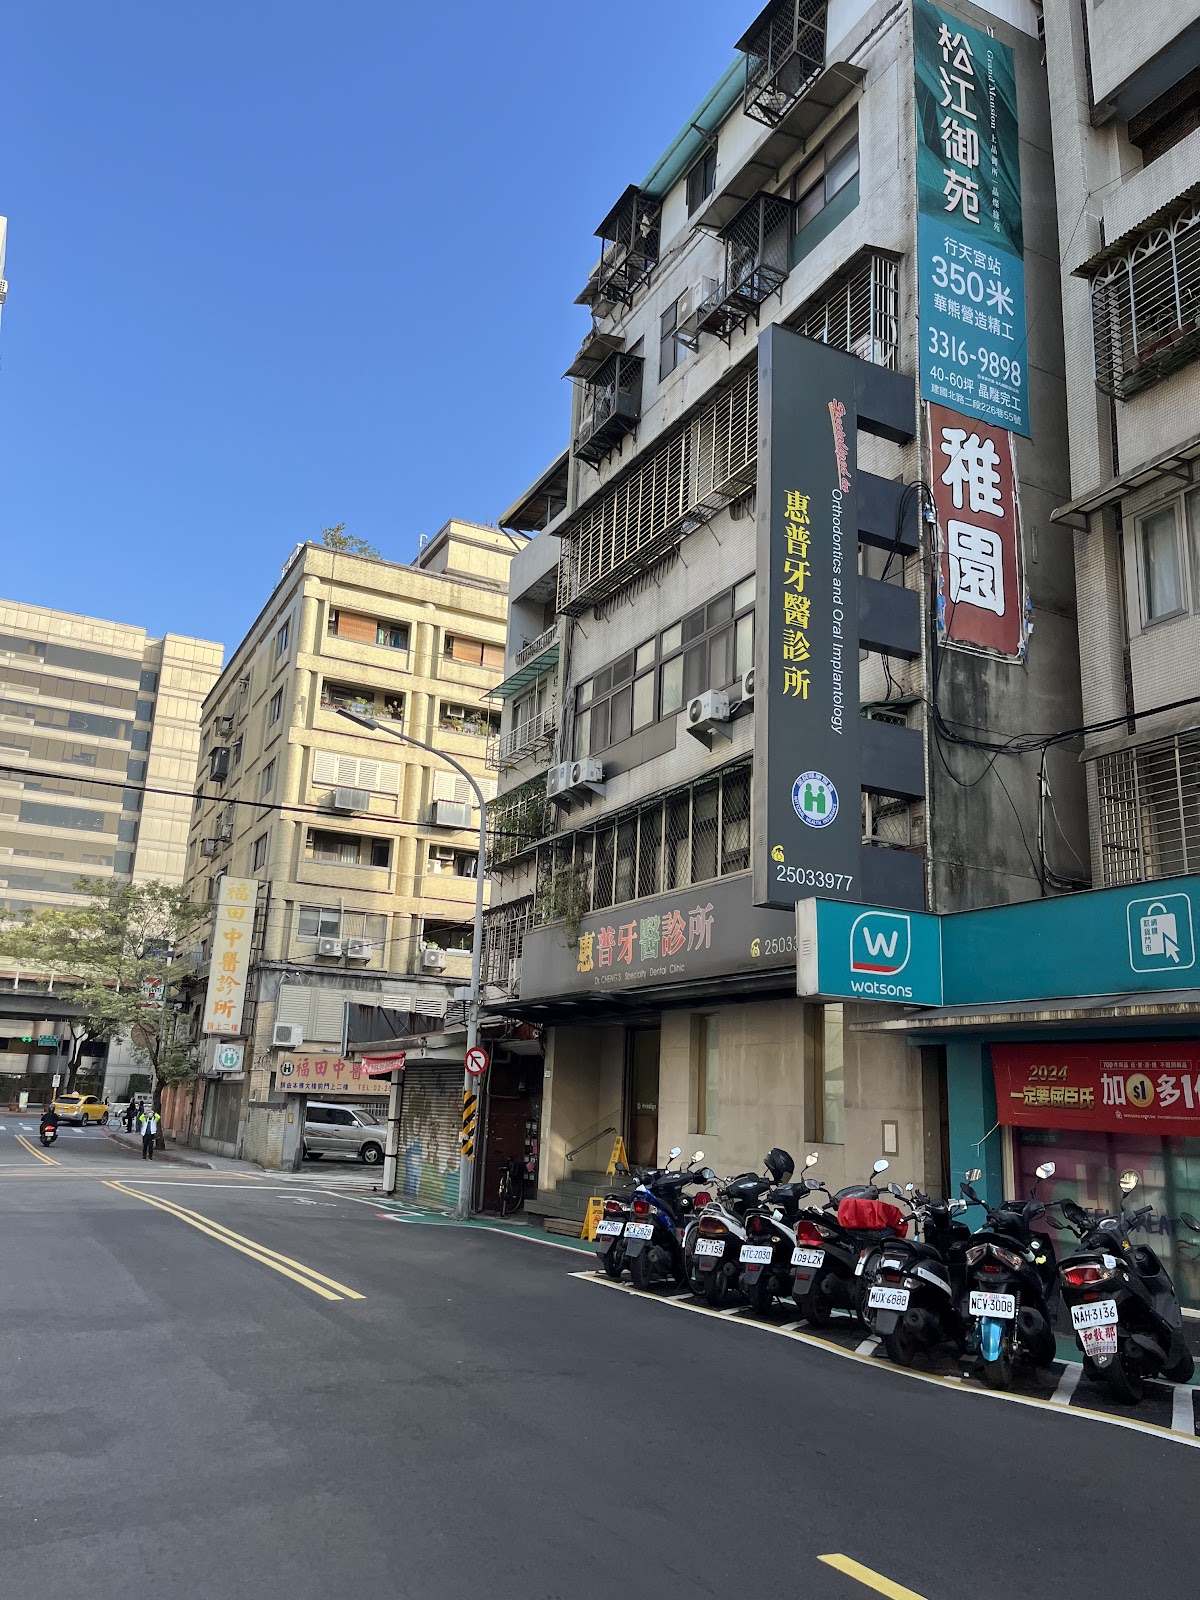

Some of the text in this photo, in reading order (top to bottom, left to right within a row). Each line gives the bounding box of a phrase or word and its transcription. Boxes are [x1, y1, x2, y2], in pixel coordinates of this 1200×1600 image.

[986, 49, 998, 129] Grand Mansion
[938, 22, 980, 224] 松江御苑
[944, 236, 1001, 277] 行天宮站
[931, 255, 1015, 317] 350米
[933, 293, 1015, 341] 華熊營造精工
[928, 326, 1021, 387] 3316-9898
[930, 365, 974, 394] 40-60坪
[783, 489, 811, 700] 惠普牙醫診所
[830, 488, 845, 735] Orthodontics and Oral Implantology
[776, 864, 853, 891] 25033977
[213, 882, 250, 1018] 福田中醫診所
[576, 903, 714, 973] 惠普牙醫診所
[851, 980, 913, 998] watsons
[1028, 1065, 1068, 1081] 2024
[1010, 1085, 1095, 1110] 一定要屈臣氏
[971, 1296, 1013, 1313] NCV-3008
[1073, 1306, 1116, 1324] NAH-3136
